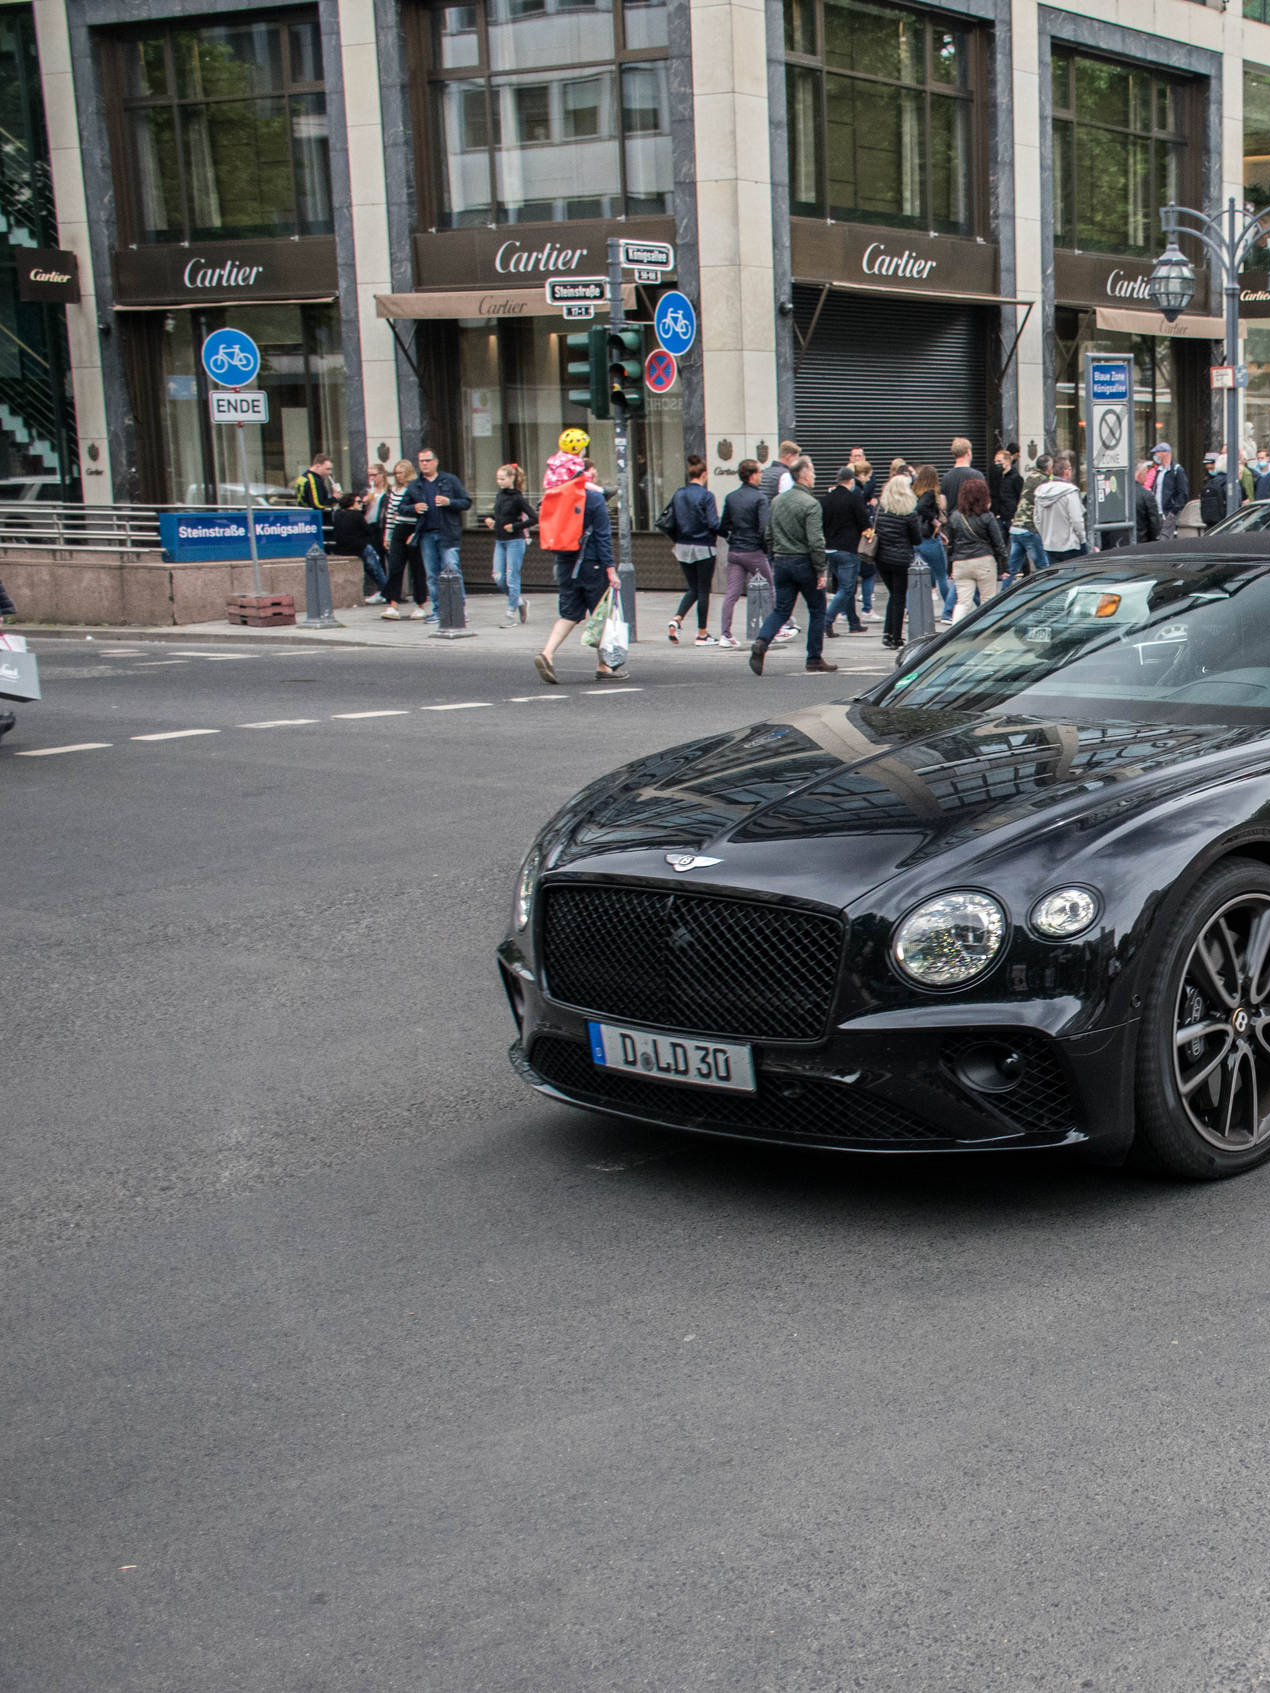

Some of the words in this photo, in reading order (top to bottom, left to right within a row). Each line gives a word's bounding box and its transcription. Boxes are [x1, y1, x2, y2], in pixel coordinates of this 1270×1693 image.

[495, 240, 588, 273] Cartier
[628, 247, 667, 263] Königsallee
[862, 242, 937, 279] Cartier
[29, 268, 72, 283] Cartier
[184, 257, 263, 288] Cartier
[554, 284, 600, 298] Steinstraße
[1106, 269, 1152, 300] Cartie
[478, 296, 528, 316] Cartier
[1094, 371, 1110, 381] Blaue
[1111, 371, 1125, 381] Zone
[1093, 383, 1127, 395] Königsallee
[216, 399, 262, 414] ENDE
[1102, 454, 1120, 465] ZONE
[178, 524, 246, 539] Steinstraße
[255, 522, 318, 537] Königsallee
[620, 1033, 638, 1066] D
[652, 1039, 689, 1075] LD
[694, 1045, 732, 1082] 30
